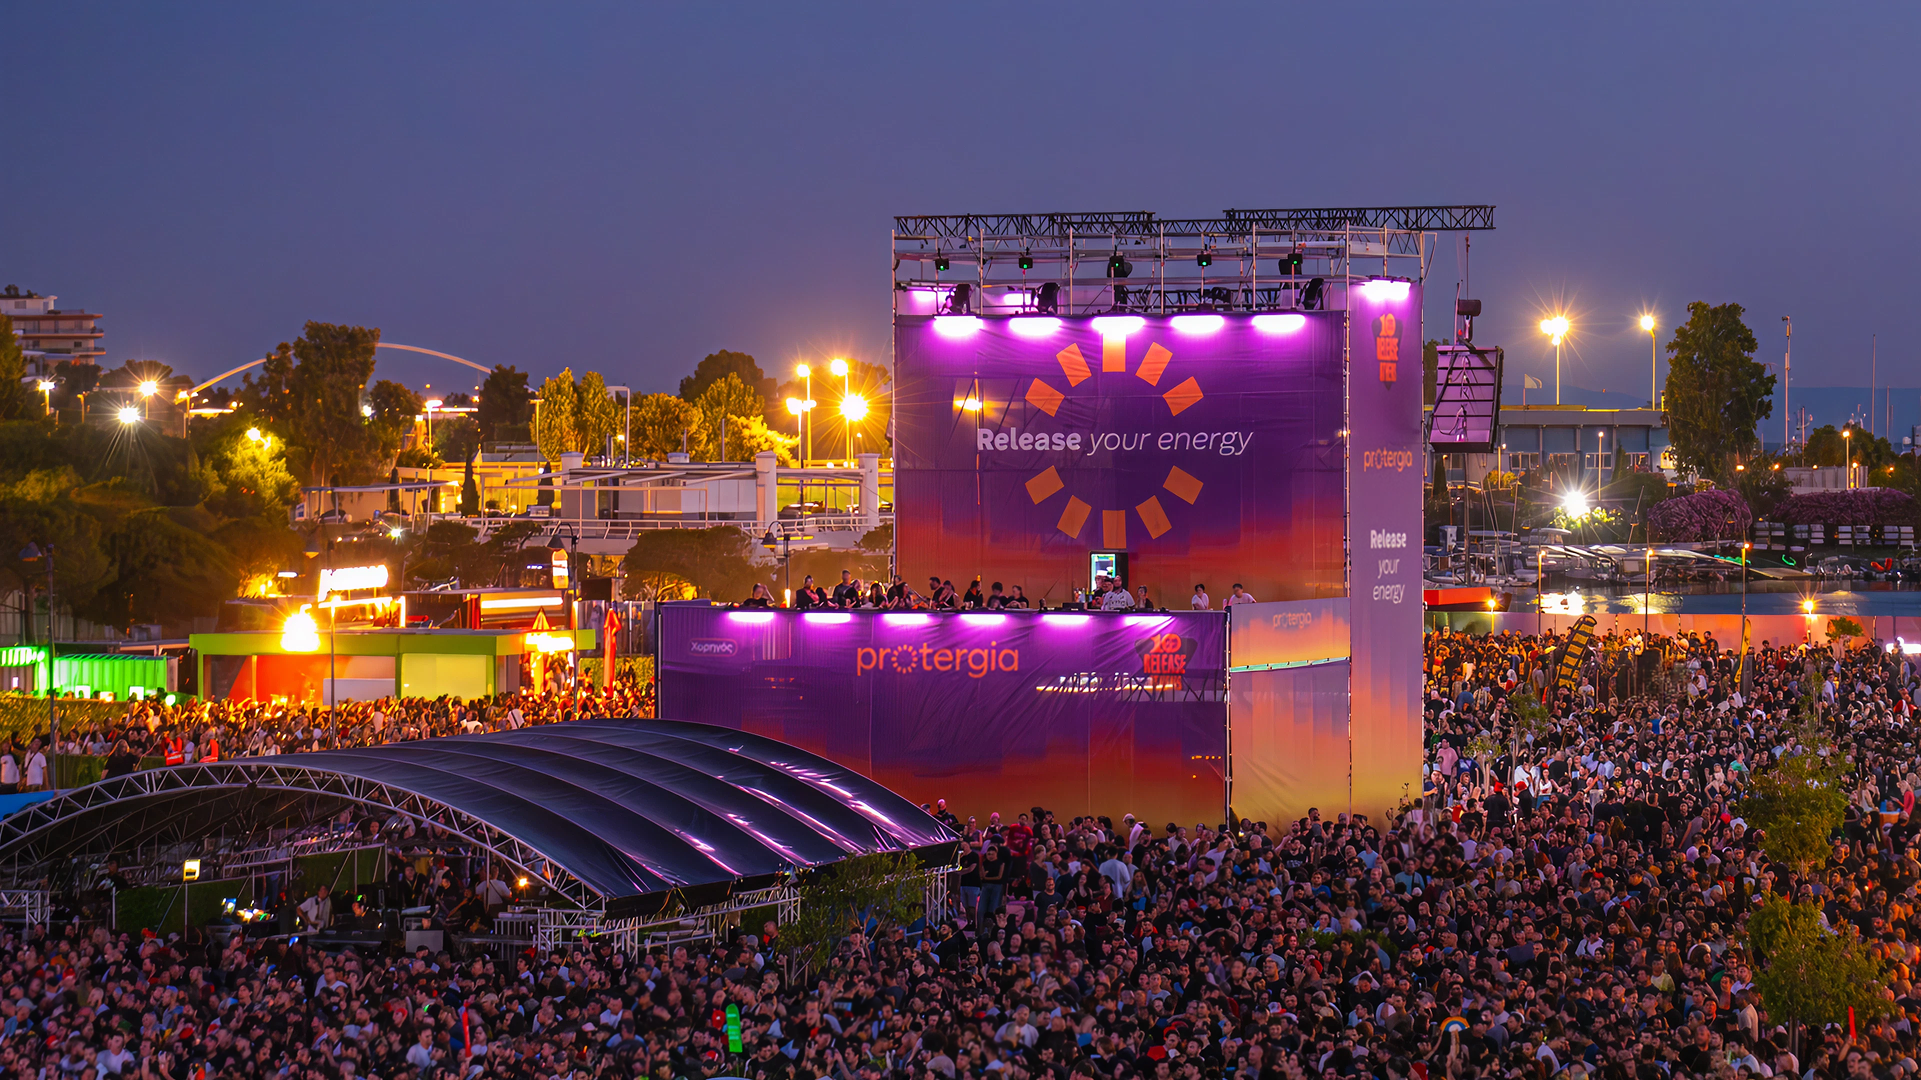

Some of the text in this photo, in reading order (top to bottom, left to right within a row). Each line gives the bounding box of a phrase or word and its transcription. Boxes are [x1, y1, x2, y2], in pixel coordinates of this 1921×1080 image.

[977, 427, 1253, 456] Release your energy
[1363, 446, 1413, 472] protergia
[1370, 529, 1407, 549] Release
[1377, 558, 1400, 579] your
[1373, 584, 1406, 604] energy
[856, 640, 1019, 678] protergia
[1143, 653, 1186, 674] RELEASE
